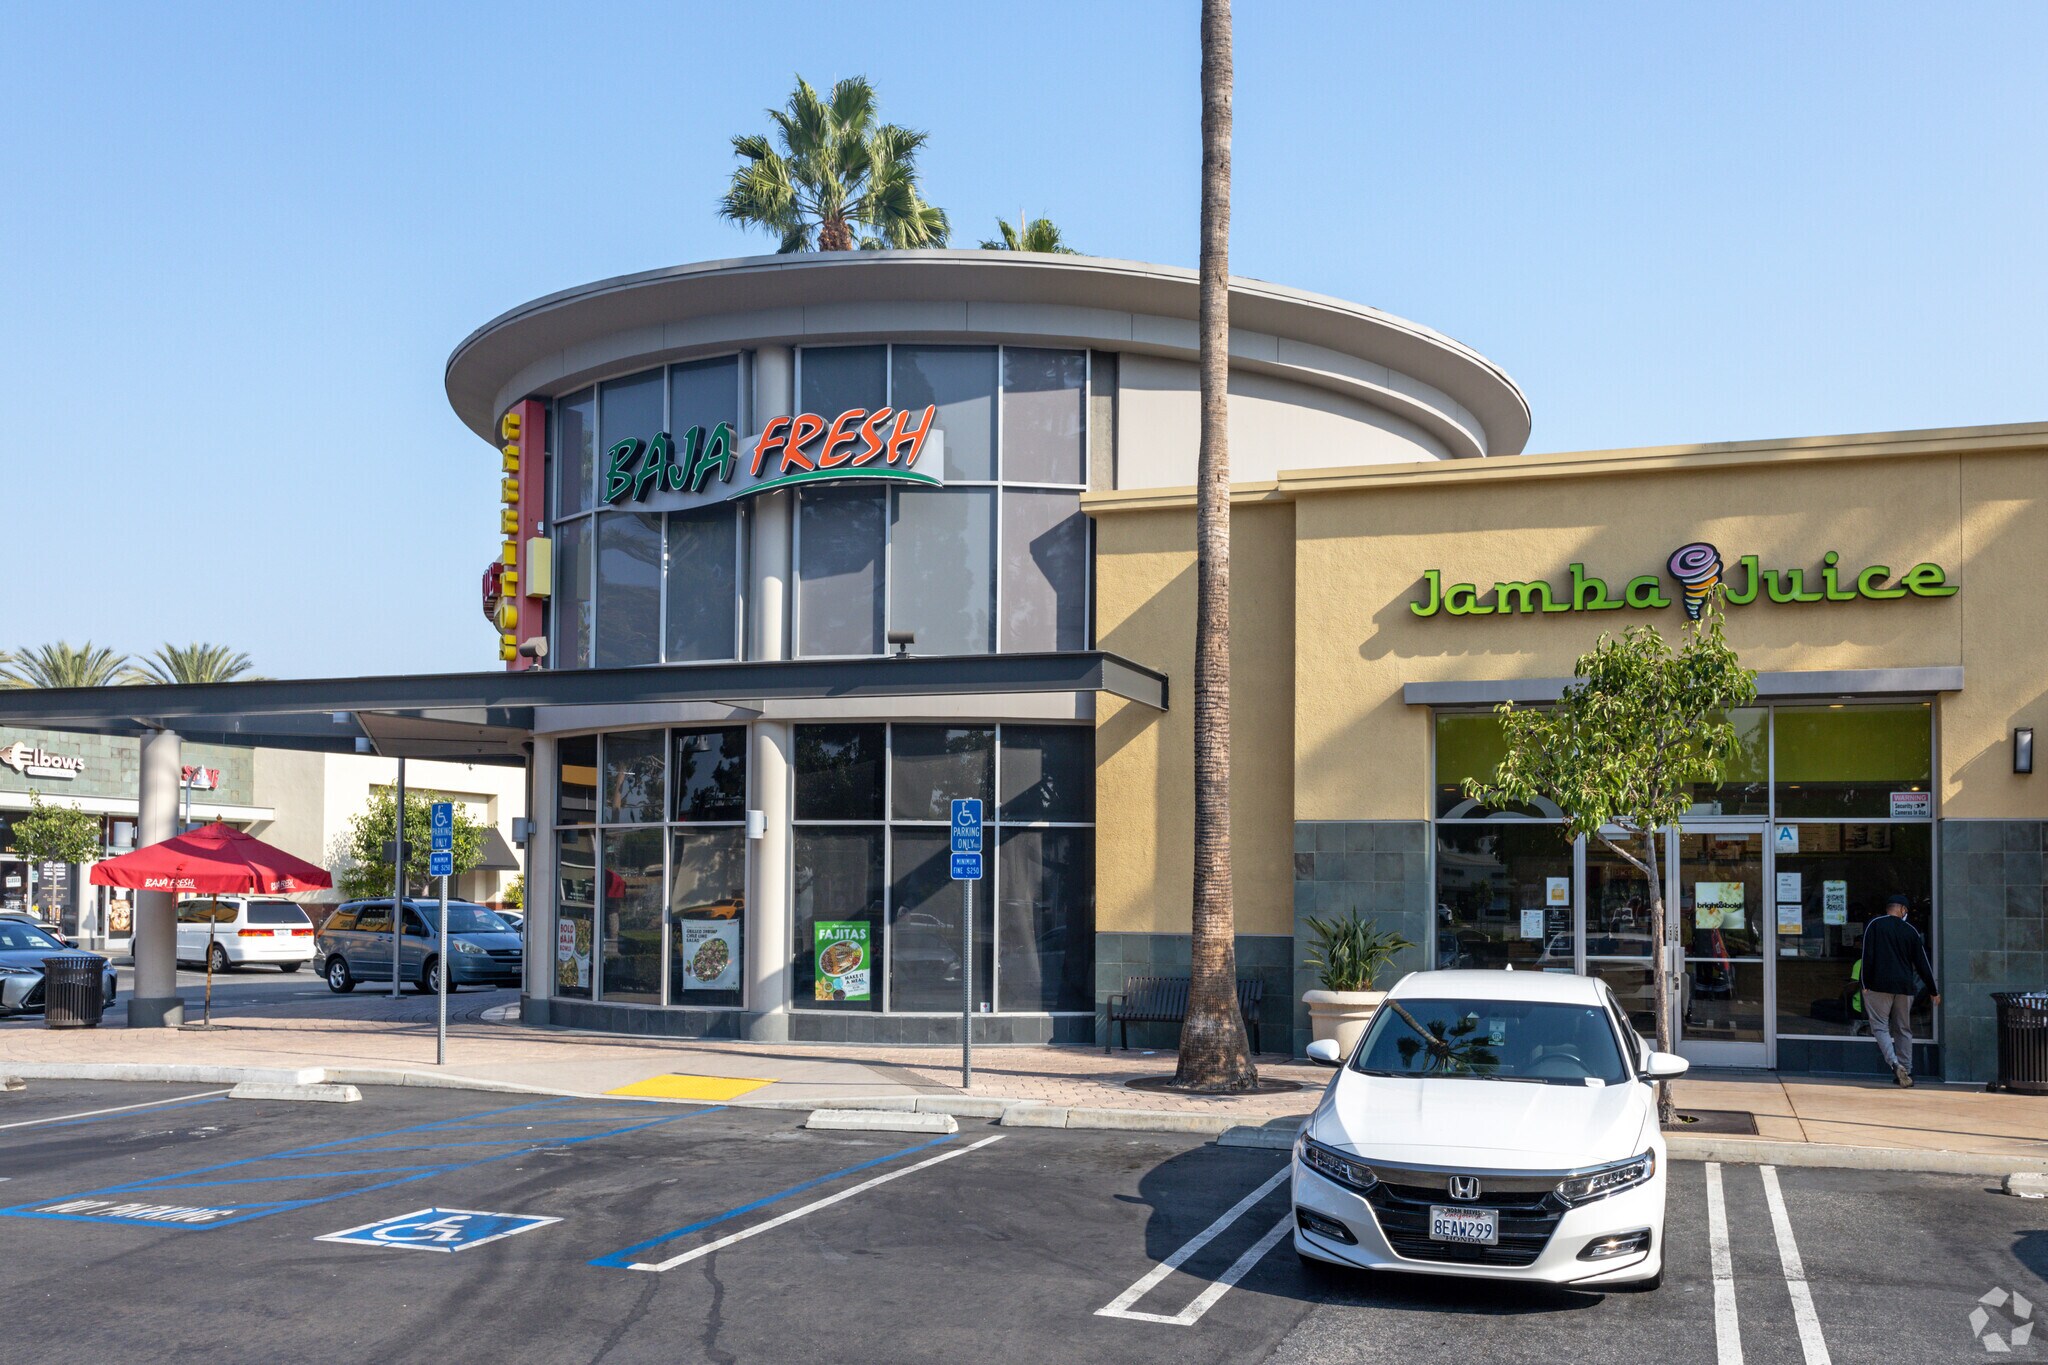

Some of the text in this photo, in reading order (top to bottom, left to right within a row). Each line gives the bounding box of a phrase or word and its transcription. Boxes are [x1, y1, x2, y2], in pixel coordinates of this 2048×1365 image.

[602, 404, 936, 503] BAJA FRESH
[1410, 551, 1960, 617] Jamba Juice
[432, 827, 451, 836] PARKING
[953, 827, 980, 837] PARKING
[1779, 827, 1793, 840] A
[435, 838, 447, 848] ONLY
[957, 839, 975, 849] ONLY
[966, 867, 979, 875] $250
[145, 878, 168, 887] BAJA
[1697, 901, 1742, 910] bright&bold
[560, 924, 574, 933] BOLD
[819, 929, 866, 939] FAJITAS
[560, 935, 574, 944] BAJA
[34, 1200, 237, 1222] NO PARKING
[1434, 1219, 1493, 1239] 8EAW299
